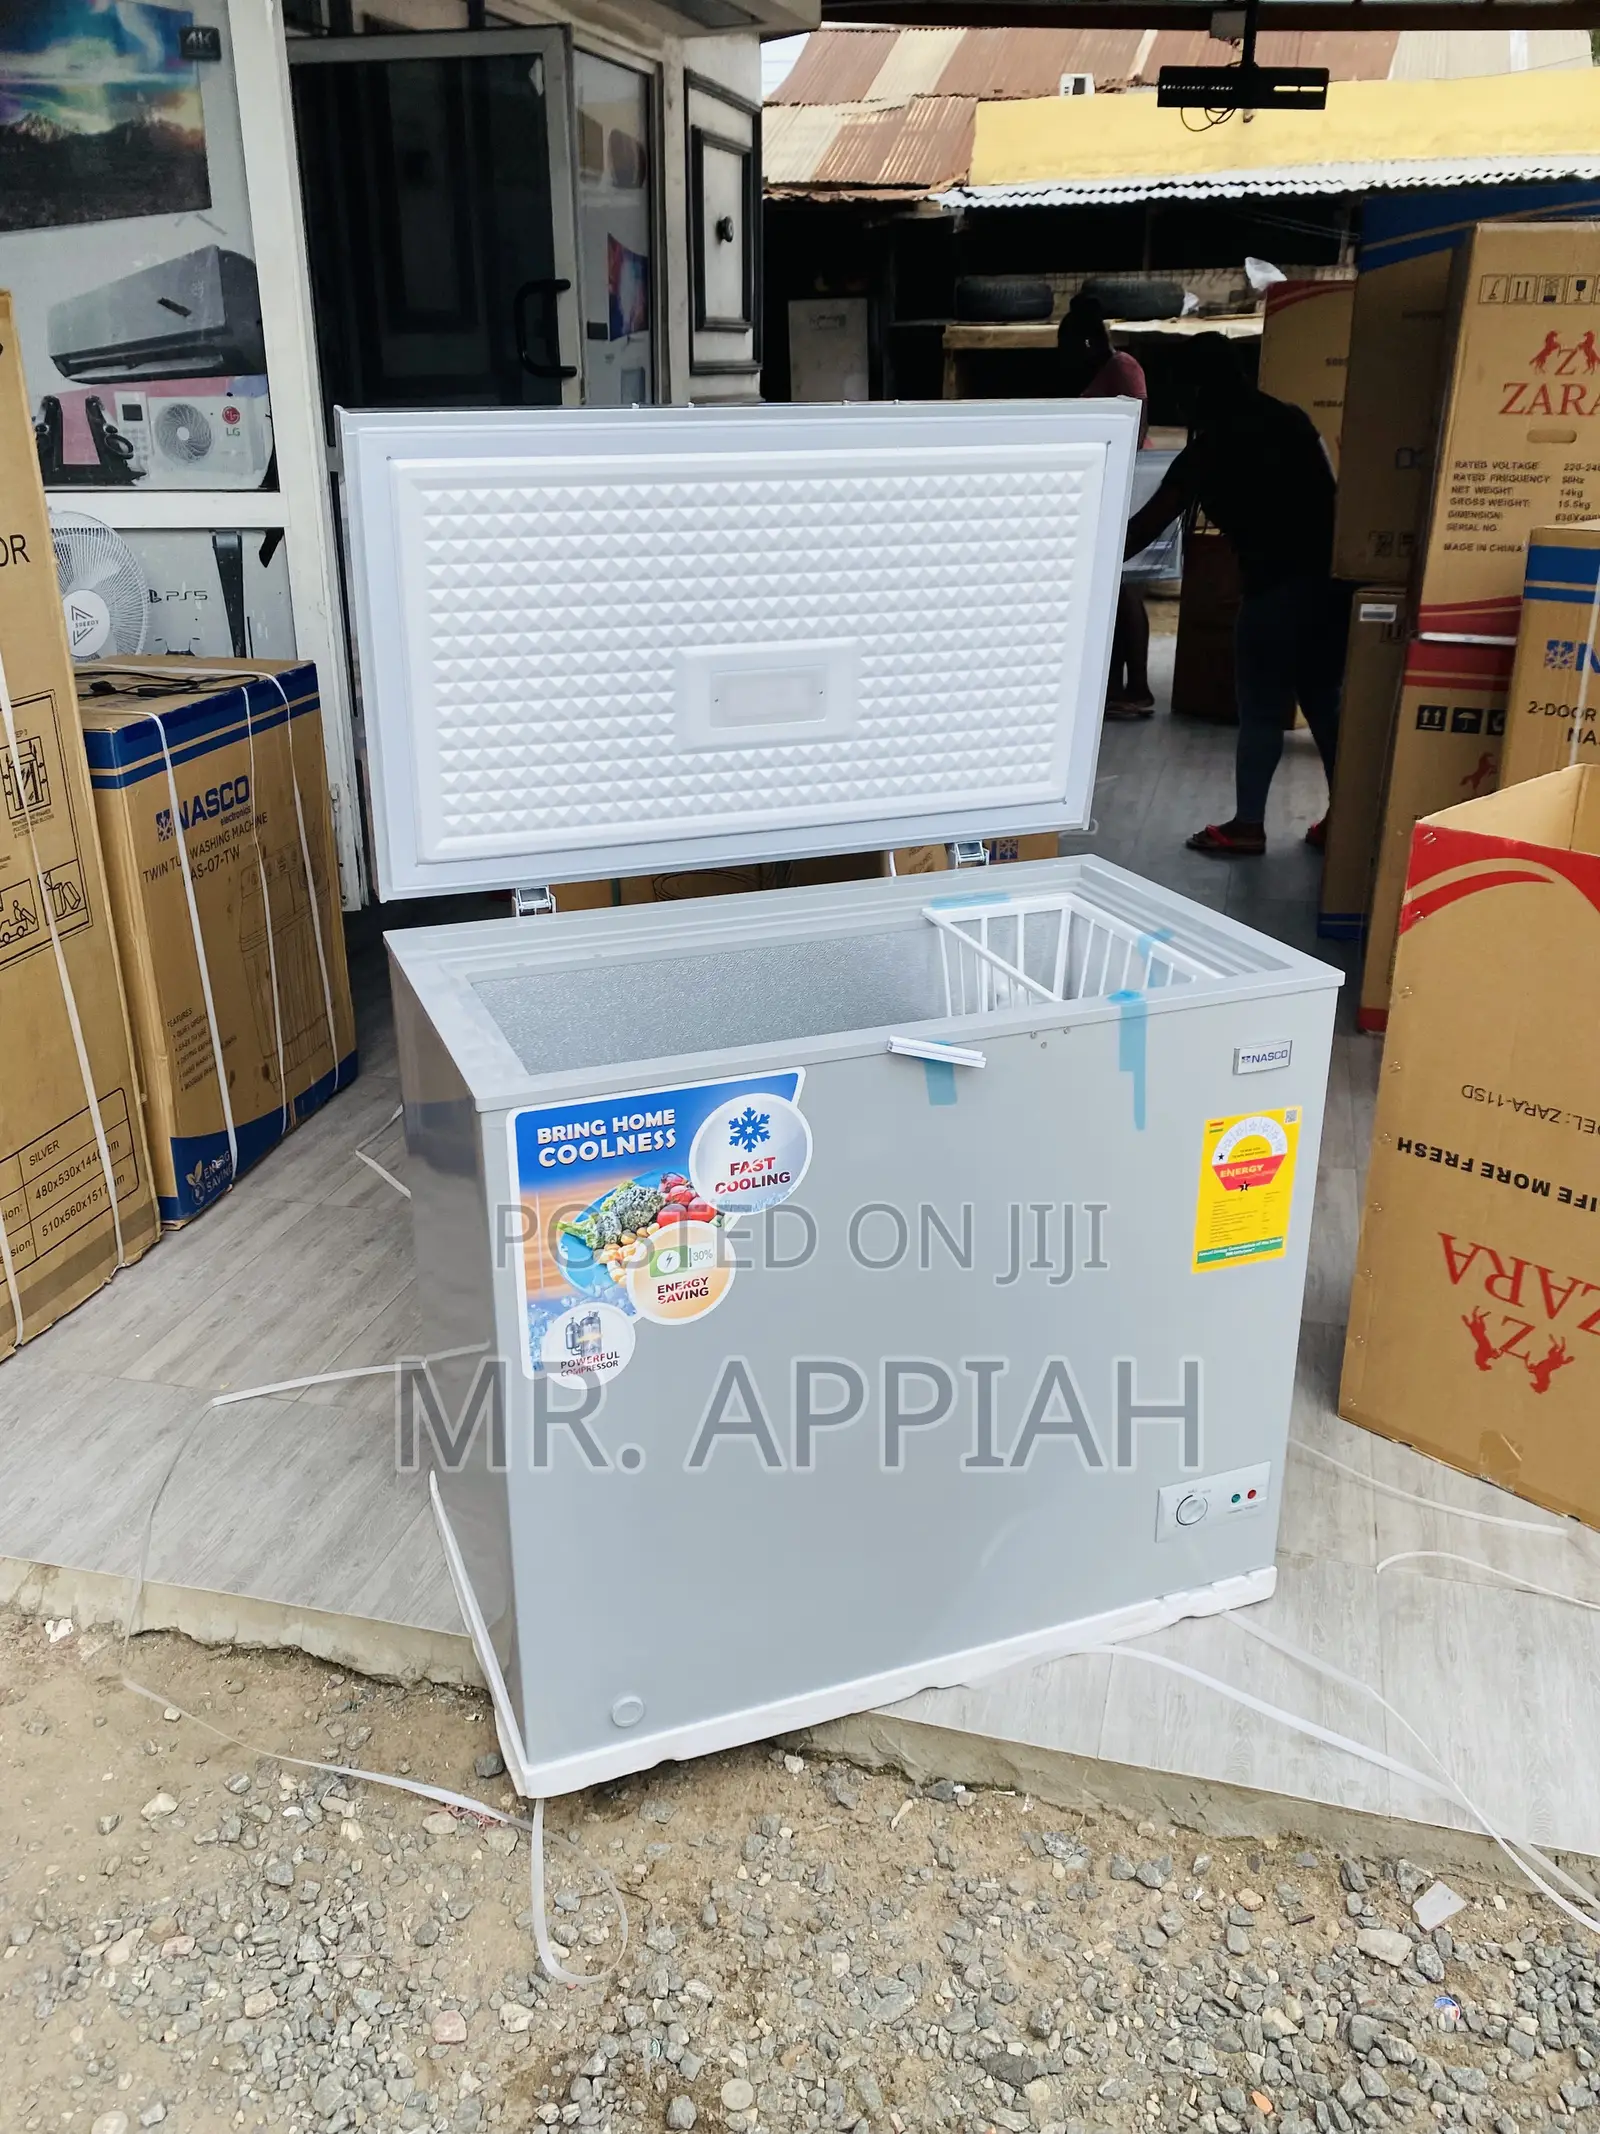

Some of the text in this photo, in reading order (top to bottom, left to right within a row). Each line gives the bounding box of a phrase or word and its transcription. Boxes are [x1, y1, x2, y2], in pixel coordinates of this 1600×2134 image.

[226, 428, 240, 437] LG
[1455, 460, 1487, 469] RATED
[1453, 473, 1485, 482] RATED
[1451, 485, 1470, 494] NET
[1450, 497, 1486, 506] GROSS
[1444, 543, 1523, 553] MADE IN CHINA
[166, 590, 208, 601] PS5
[143, 860, 169, 883] TWIN
[170, 855, 182, 868] TU
[189, 833, 231, 860] WASHING
[183, 844, 240, 885] AS-07-TW
[1252, 1050, 1288, 1063] NASCO
[1461, 1084, 1600, 1135] EL: ZARA-11SD
[537, 1108, 676, 1145] BRING HOME
[29, 1139, 60, 1166] SILVER
[538, 1128, 677, 1168] COOLNESS
[730, 1157, 776, 1176] FAST
[1220, 1164, 1264, 1178] ENERGY
[1396, 1136, 1600, 1212] IFE MORE FRESH
[715, 1171, 791, 1194] COOLING
[693, 1249, 714, 1261] 30%
[657, 1277, 709, 1294] ENERGY
[657, 1287, 709, 1304] SAVING
[560, 1350, 620, 1369] POWERFUL
[561, 1360, 618, 1377] COMPRESSOR
